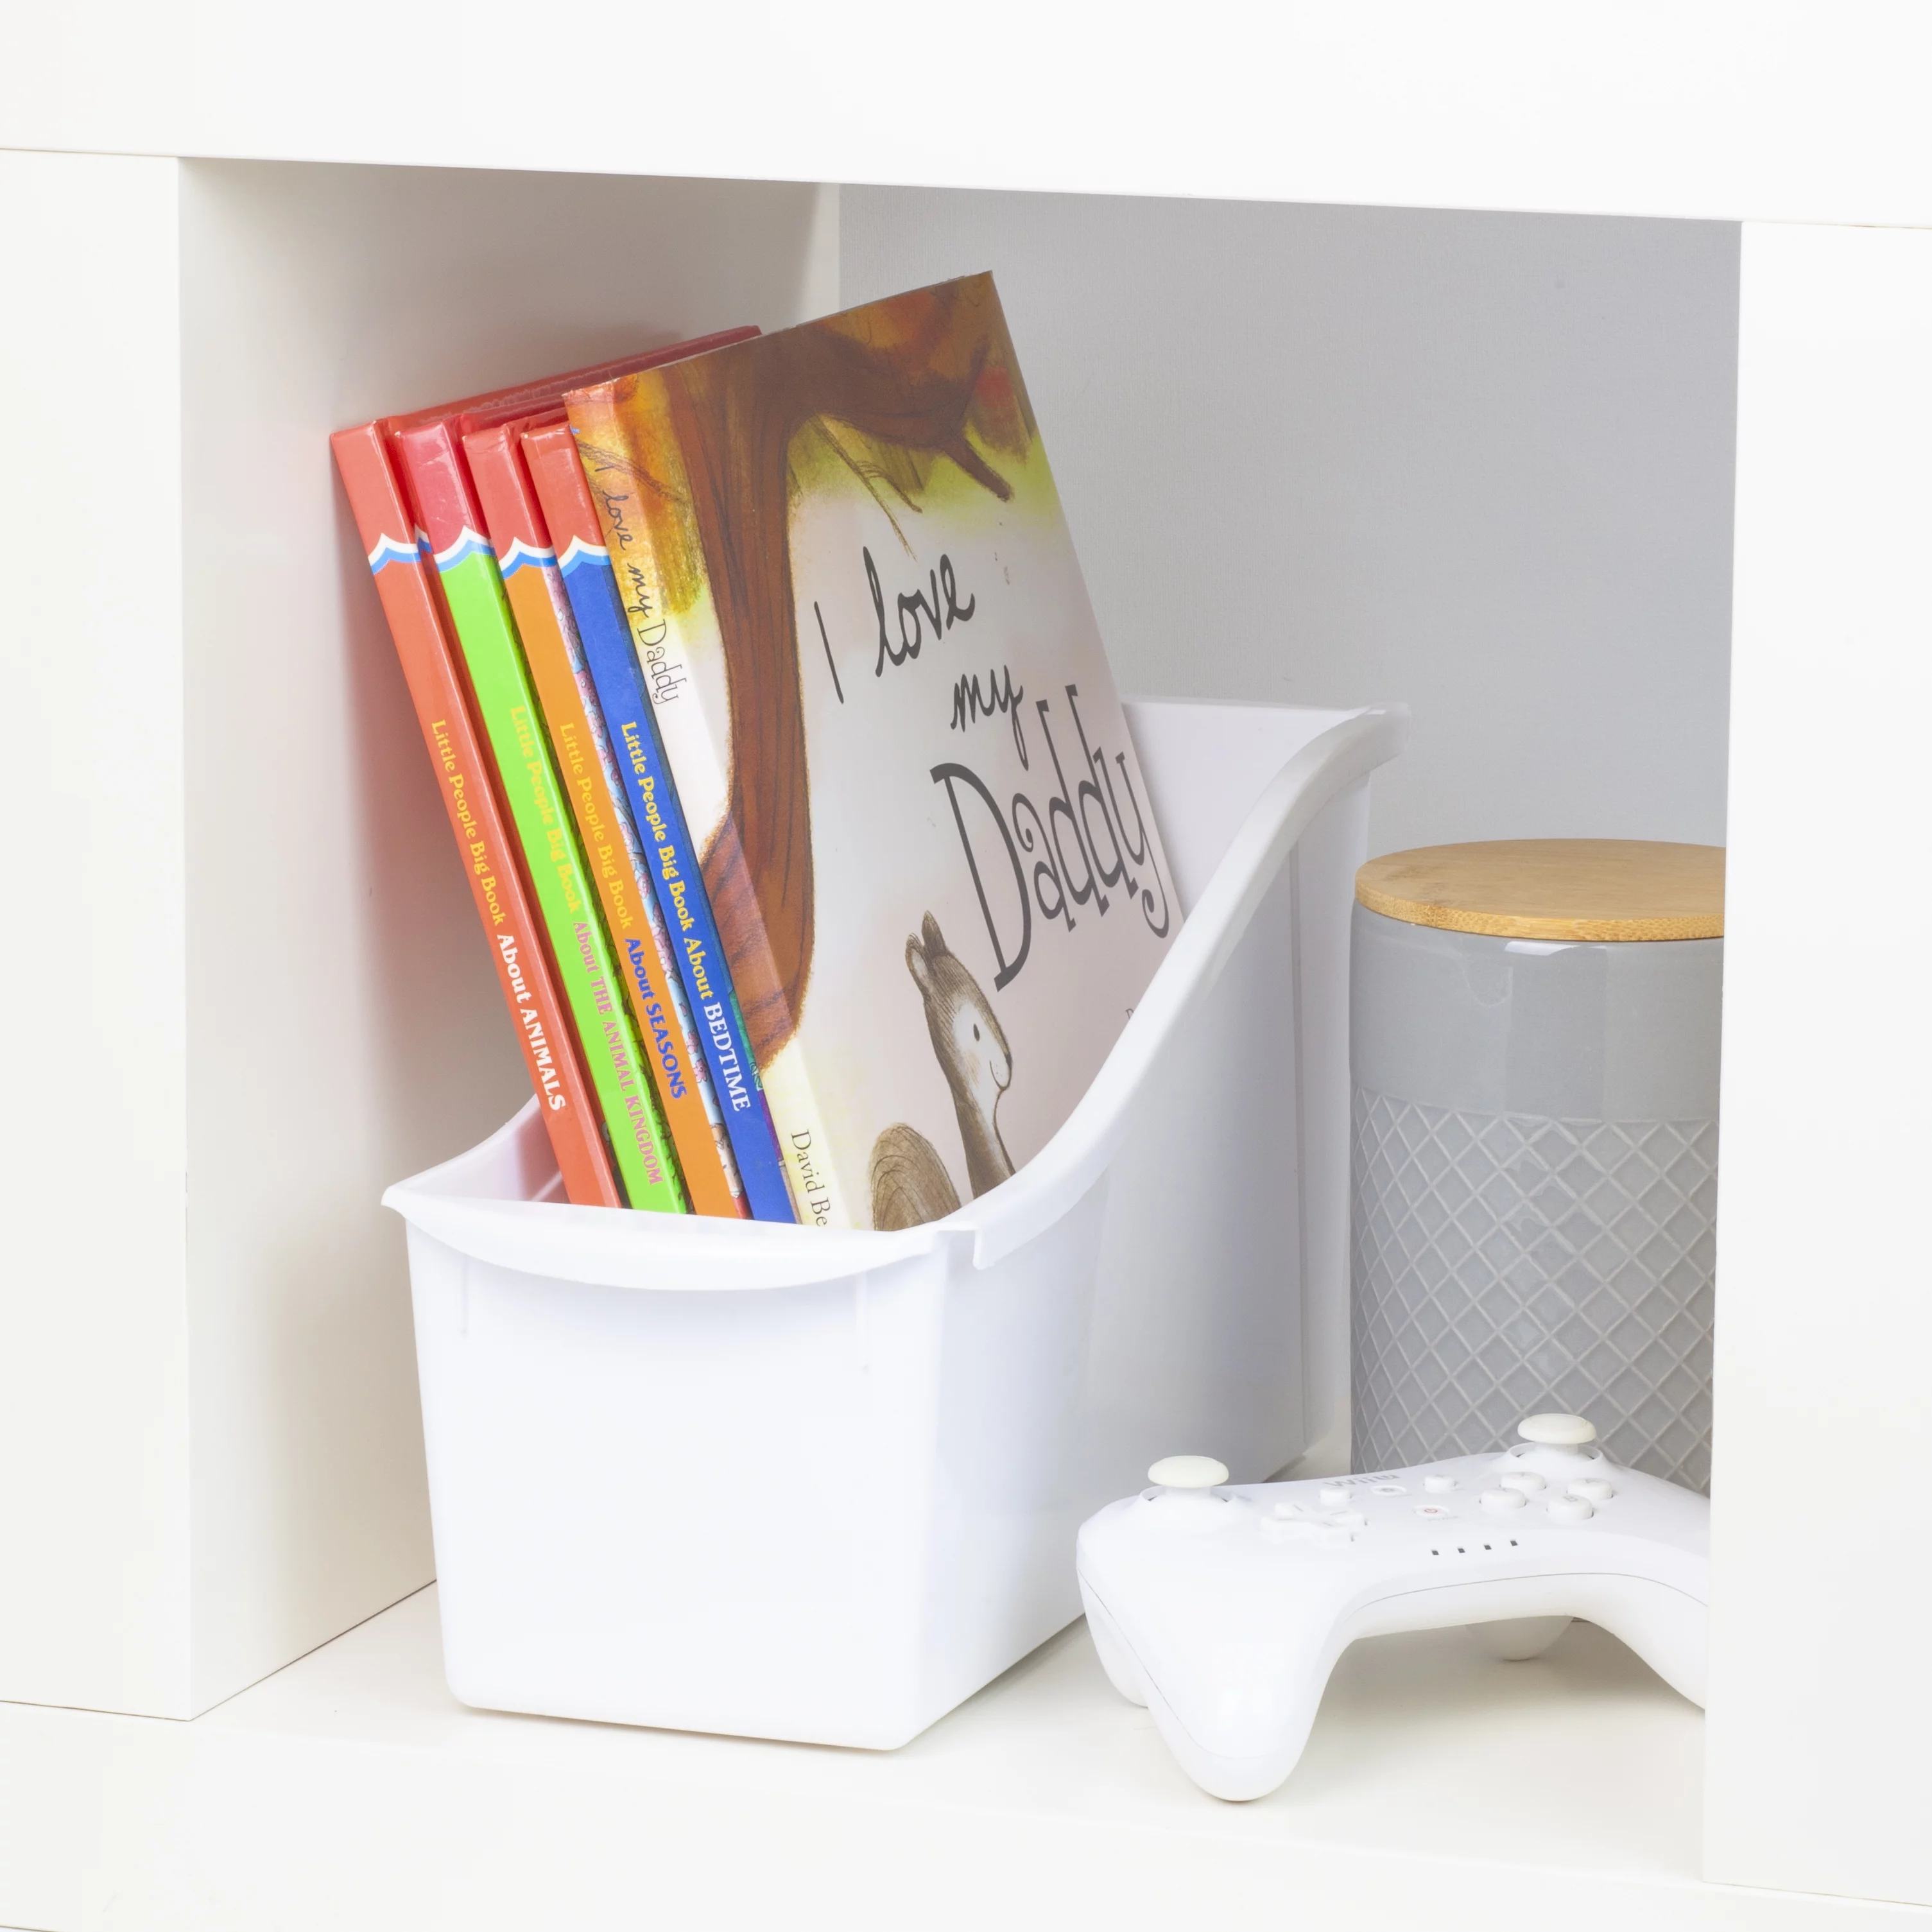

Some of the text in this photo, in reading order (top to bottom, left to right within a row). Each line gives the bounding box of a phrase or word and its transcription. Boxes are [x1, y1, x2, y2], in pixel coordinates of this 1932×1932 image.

[594, 463, 687, 705] I love my Daddy
[814, 546, 975, 704] I love
[950, 664, 1029, 772] my
[431, 720, 566, 1111] Little People Big Book About ANIMALS
[510, 705, 664, 1186] Little People Big Book About THE ANIMAL KINGDOM
[560, 722, 687, 1100] Little People Big Book About SEASONS
[621, 721, 751, 1112] Little People Big Book About BEDTIME
[929, 684, 1169, 992] Daddy
[790, 1128, 825, 1194] David
